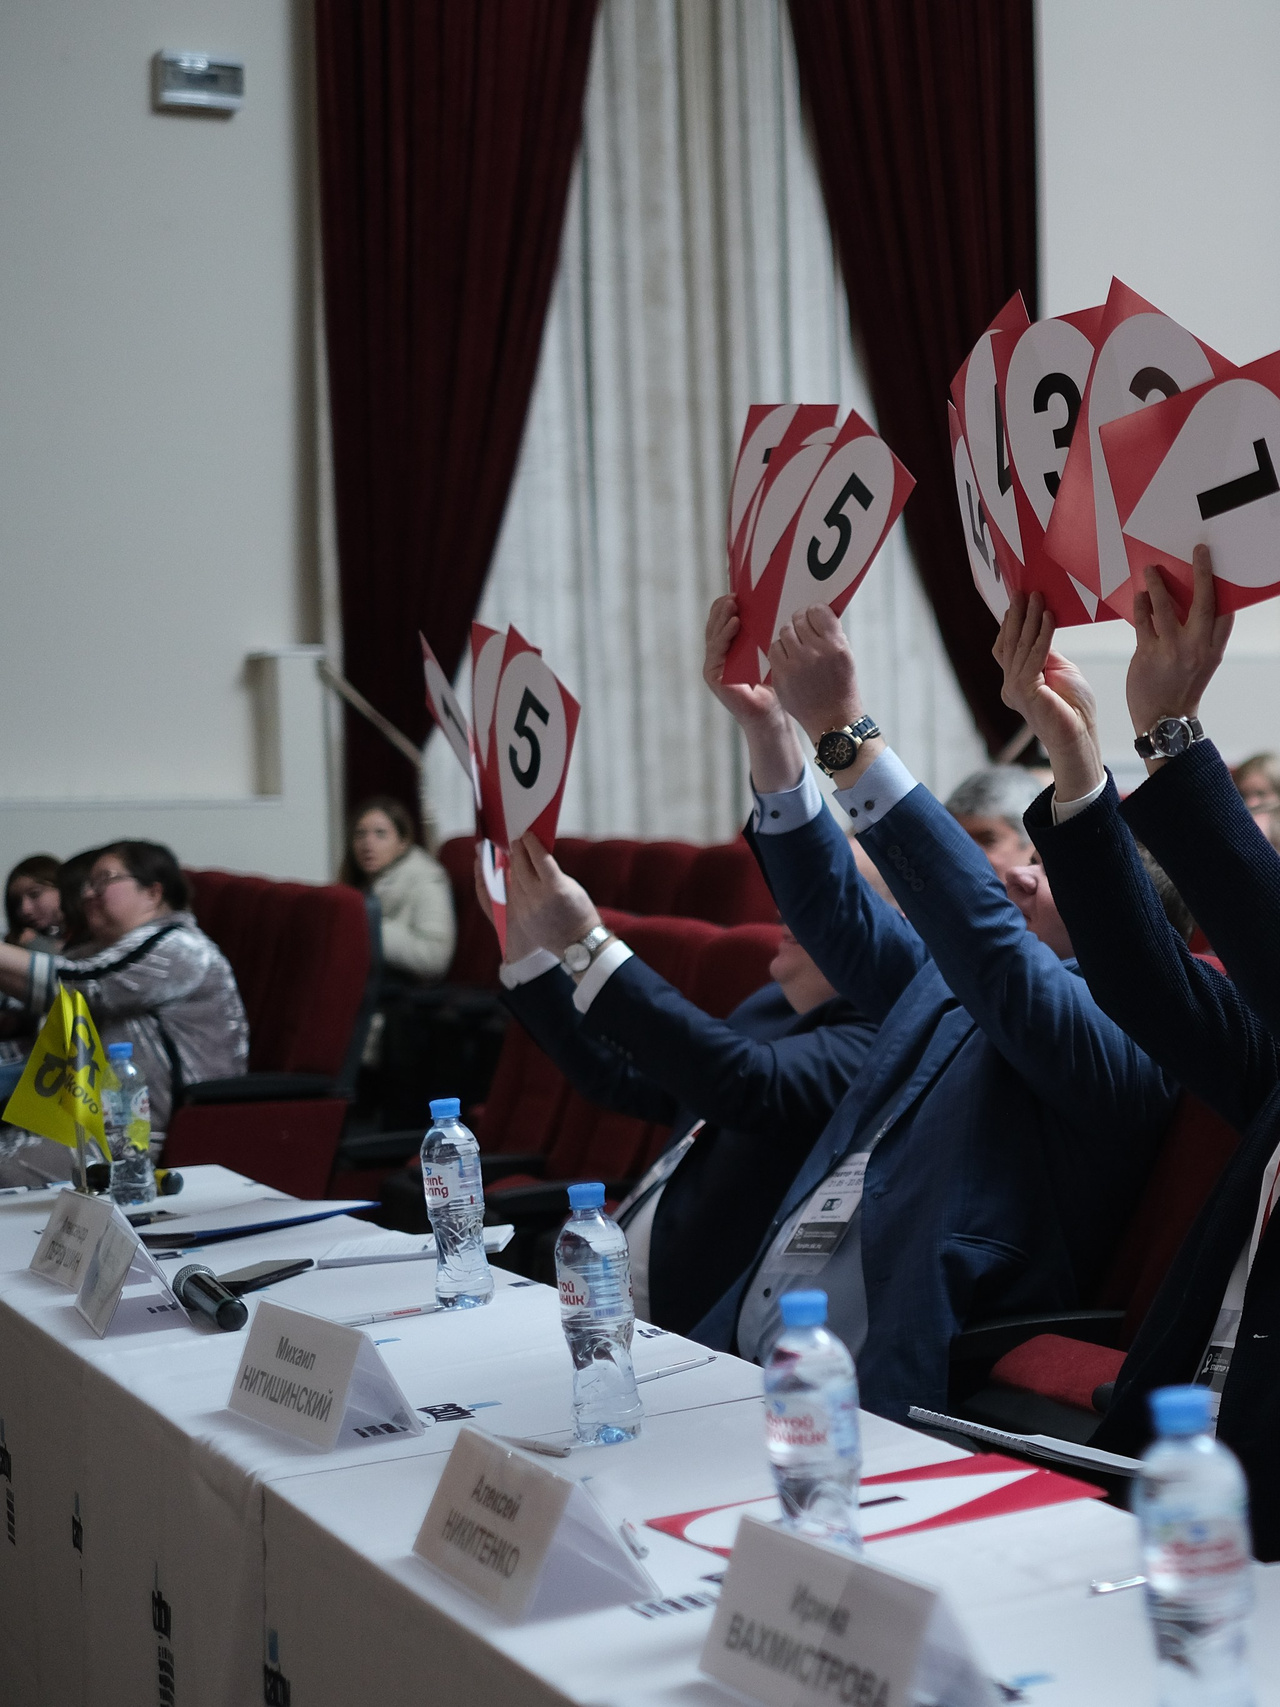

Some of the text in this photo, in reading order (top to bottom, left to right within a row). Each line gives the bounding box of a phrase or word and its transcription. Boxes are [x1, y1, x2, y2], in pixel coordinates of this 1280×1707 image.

[1196, 437, 1280, 521] 1
[807, 473, 874, 581] 5
[509, 686, 549, 788] 5
[275, 1336, 317, 1371] Михаил
[239, 1364, 334, 1423] НИТИШИНСКИЙ
[471, 1475, 523, 1523] Алексей
[440, 1507, 521, 1580] НИКИТЕНКО
